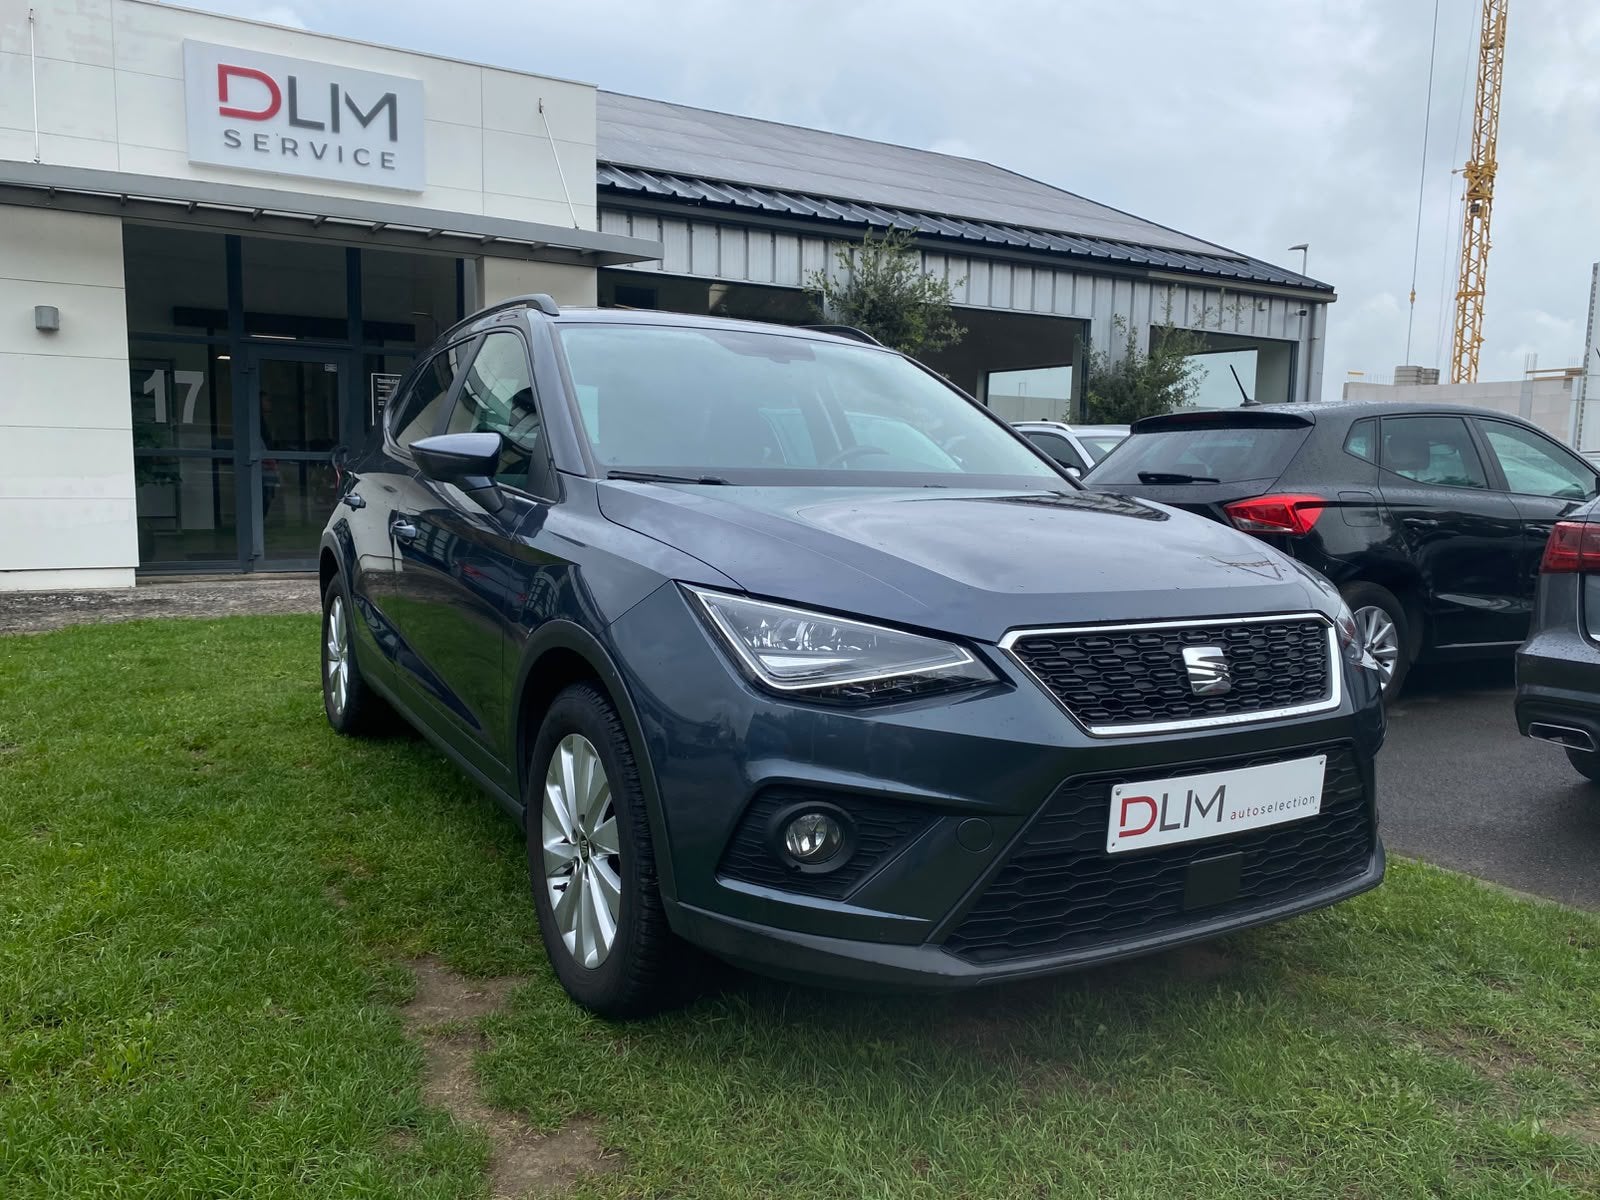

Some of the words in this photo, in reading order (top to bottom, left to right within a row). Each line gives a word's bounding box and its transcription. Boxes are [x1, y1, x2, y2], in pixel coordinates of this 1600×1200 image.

[223, 128, 396, 171] SERVICE
[143, 369, 204, 424] 17
[1230, 795, 1316, 820] autoselection
